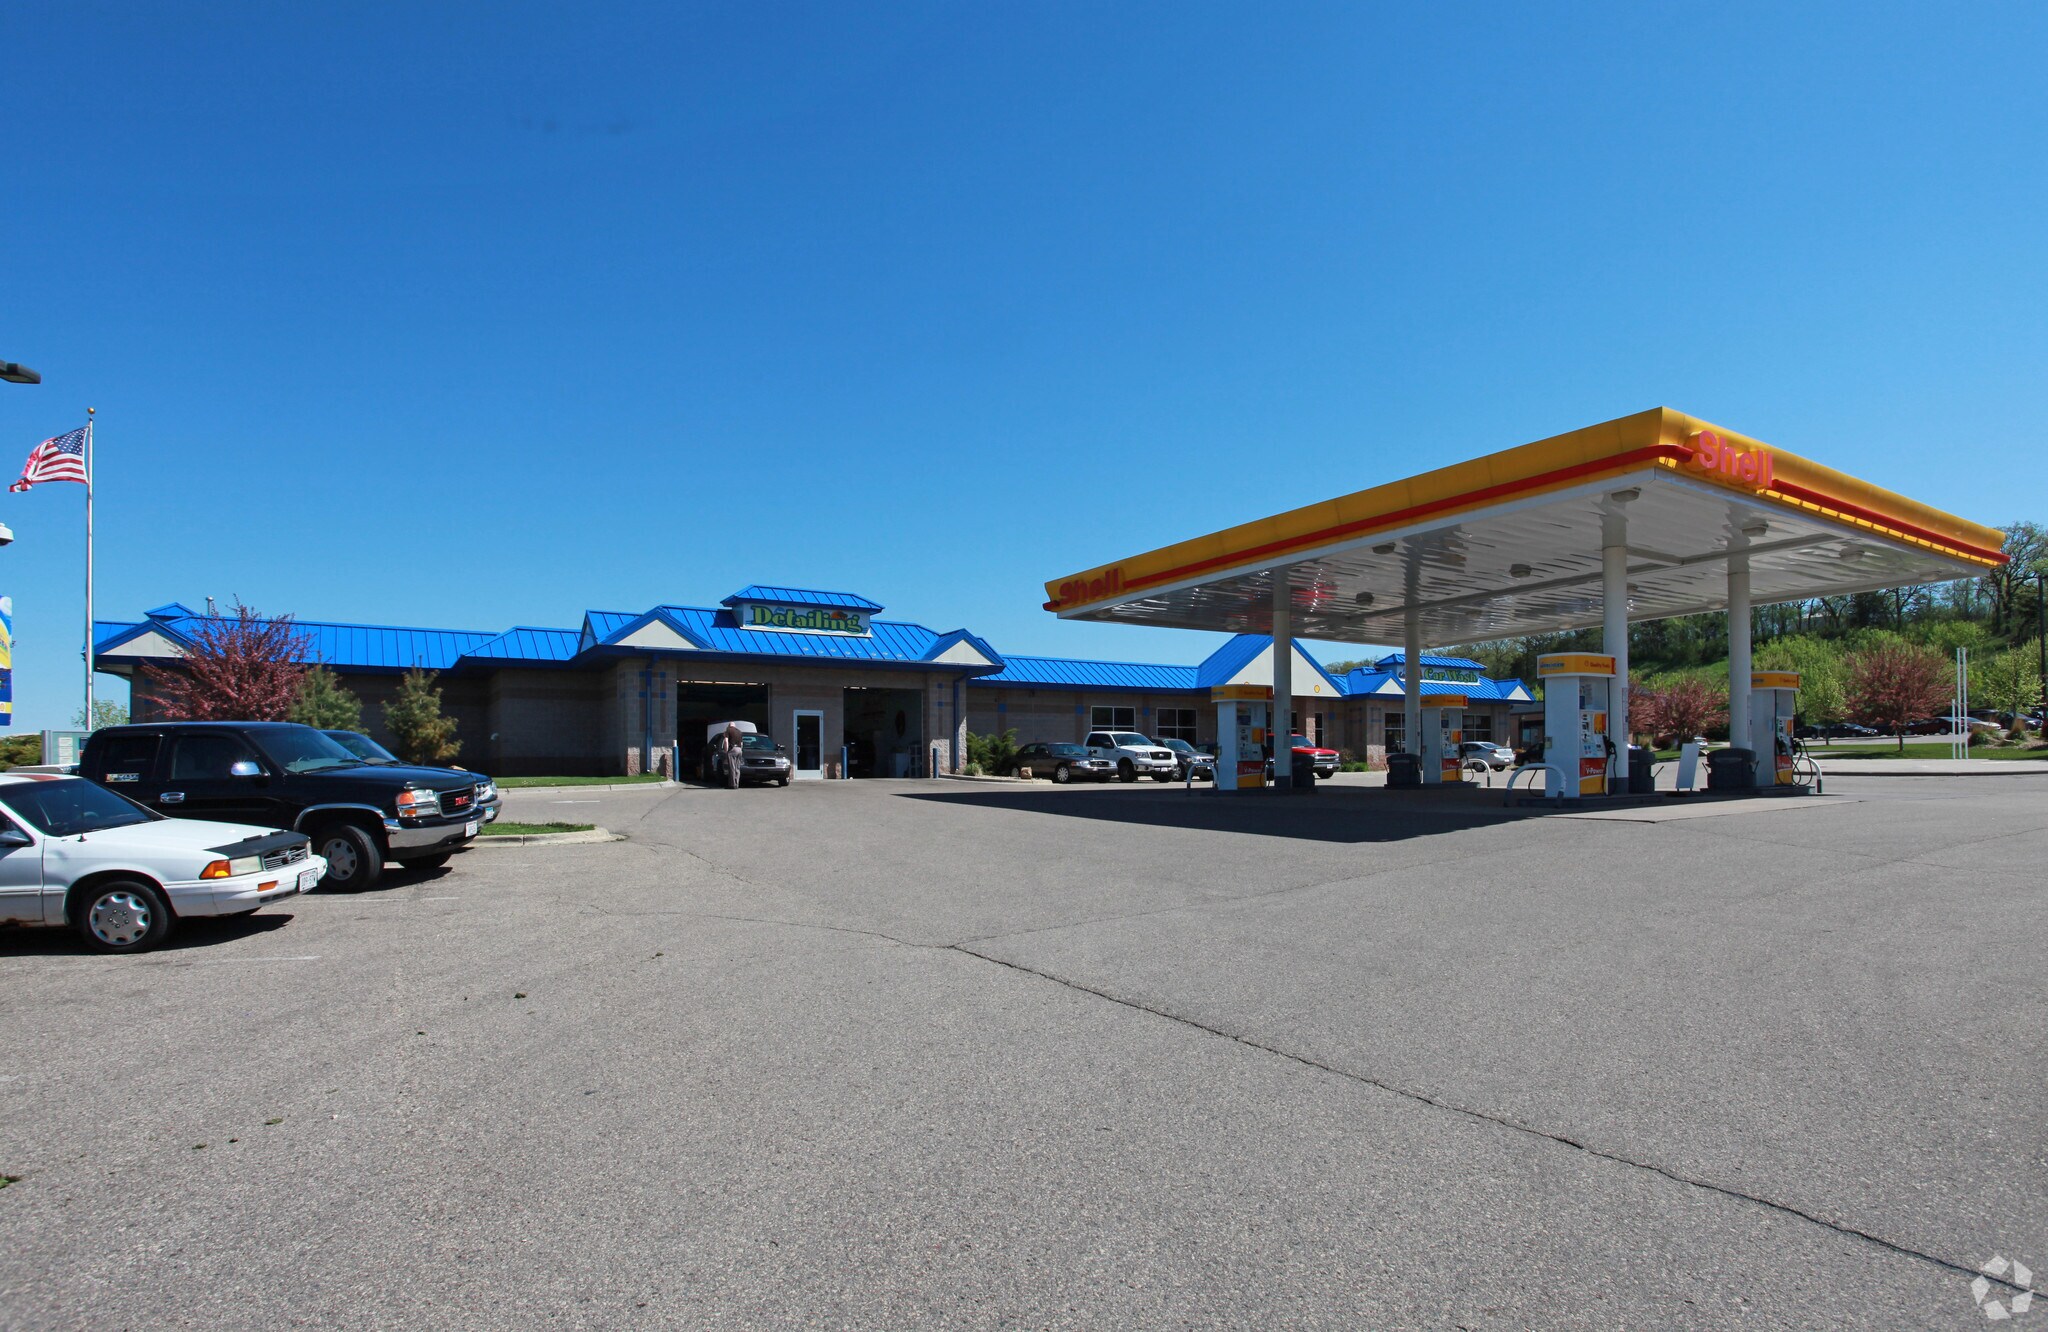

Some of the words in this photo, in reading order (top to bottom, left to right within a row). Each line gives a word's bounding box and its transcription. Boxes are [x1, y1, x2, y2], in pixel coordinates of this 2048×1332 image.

[1698, 430, 1773, 487] Shell
[1059, 568, 1119, 604] Shell
[751, 605, 863, 635] Detailing
[1424, 668, 1445, 681] Car
[1445, 669, 1478, 683] Wash
